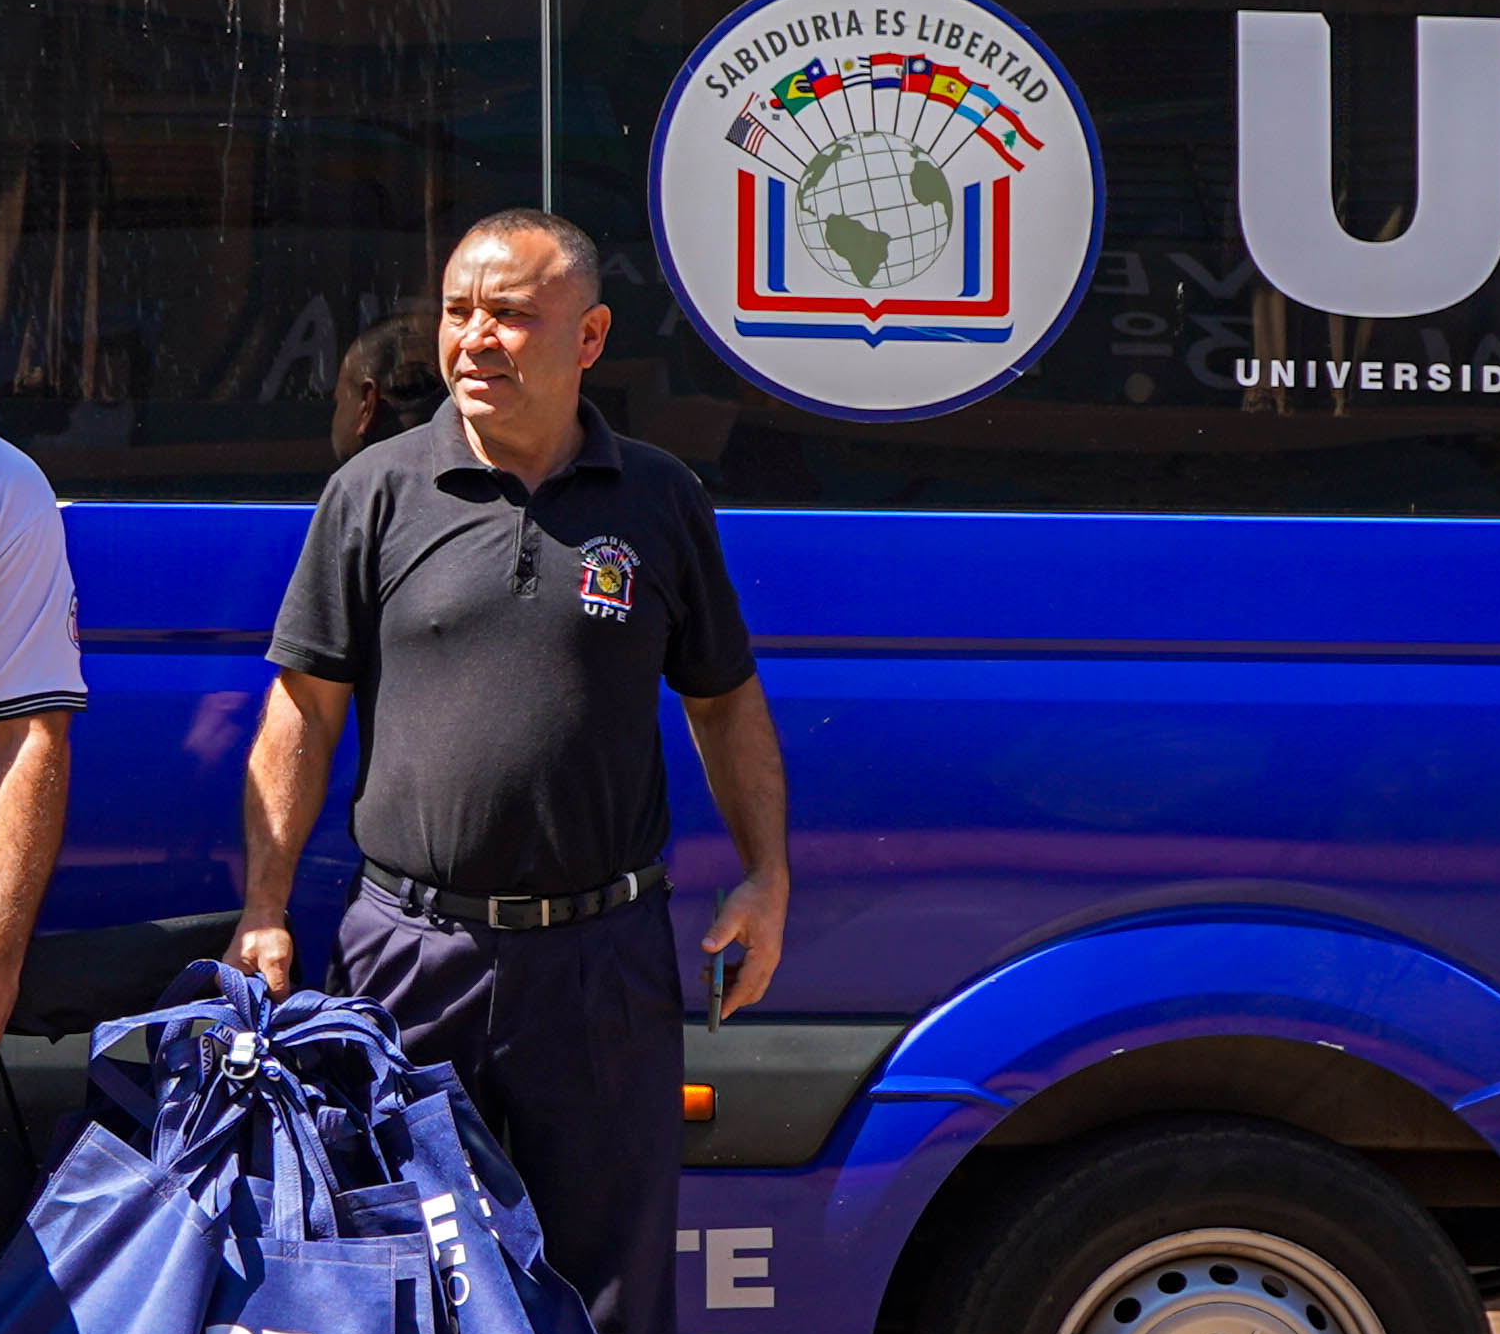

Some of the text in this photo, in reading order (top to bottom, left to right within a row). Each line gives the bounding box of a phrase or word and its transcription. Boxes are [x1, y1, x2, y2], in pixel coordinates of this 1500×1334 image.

[704, 8, 1049, 105] SABIDURIA ES LIBERTAD
[583, 602, 629, 624] UPE
